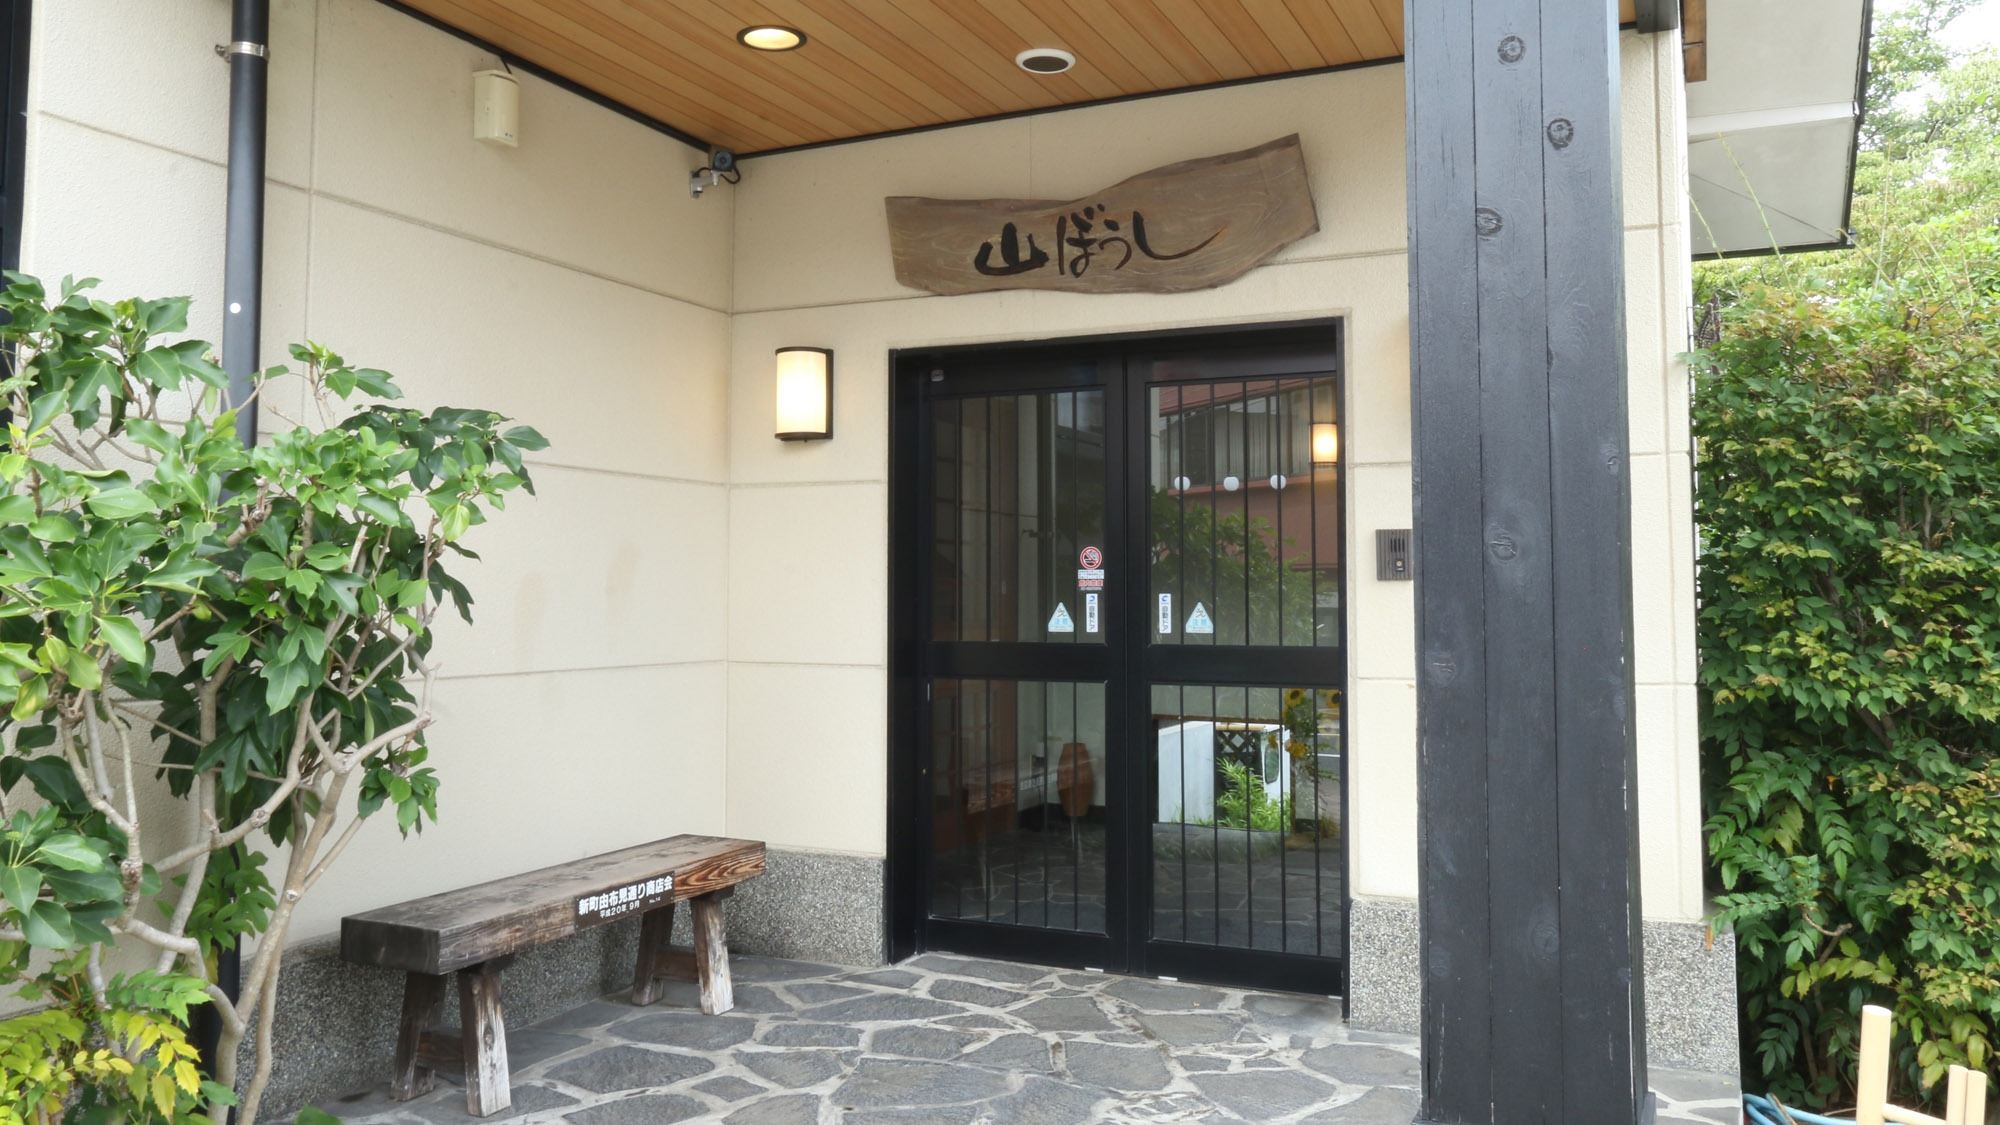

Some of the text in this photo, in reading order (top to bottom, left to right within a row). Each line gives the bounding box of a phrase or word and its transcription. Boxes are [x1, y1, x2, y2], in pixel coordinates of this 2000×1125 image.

[973, 203, 1229, 278] 山ぼうし
[1088, 605, 1096, 631] 自動ドア
[1161, 605, 1169, 632] 自動ドア
[578, 875, 673, 916] 新町由布見通り商店会
